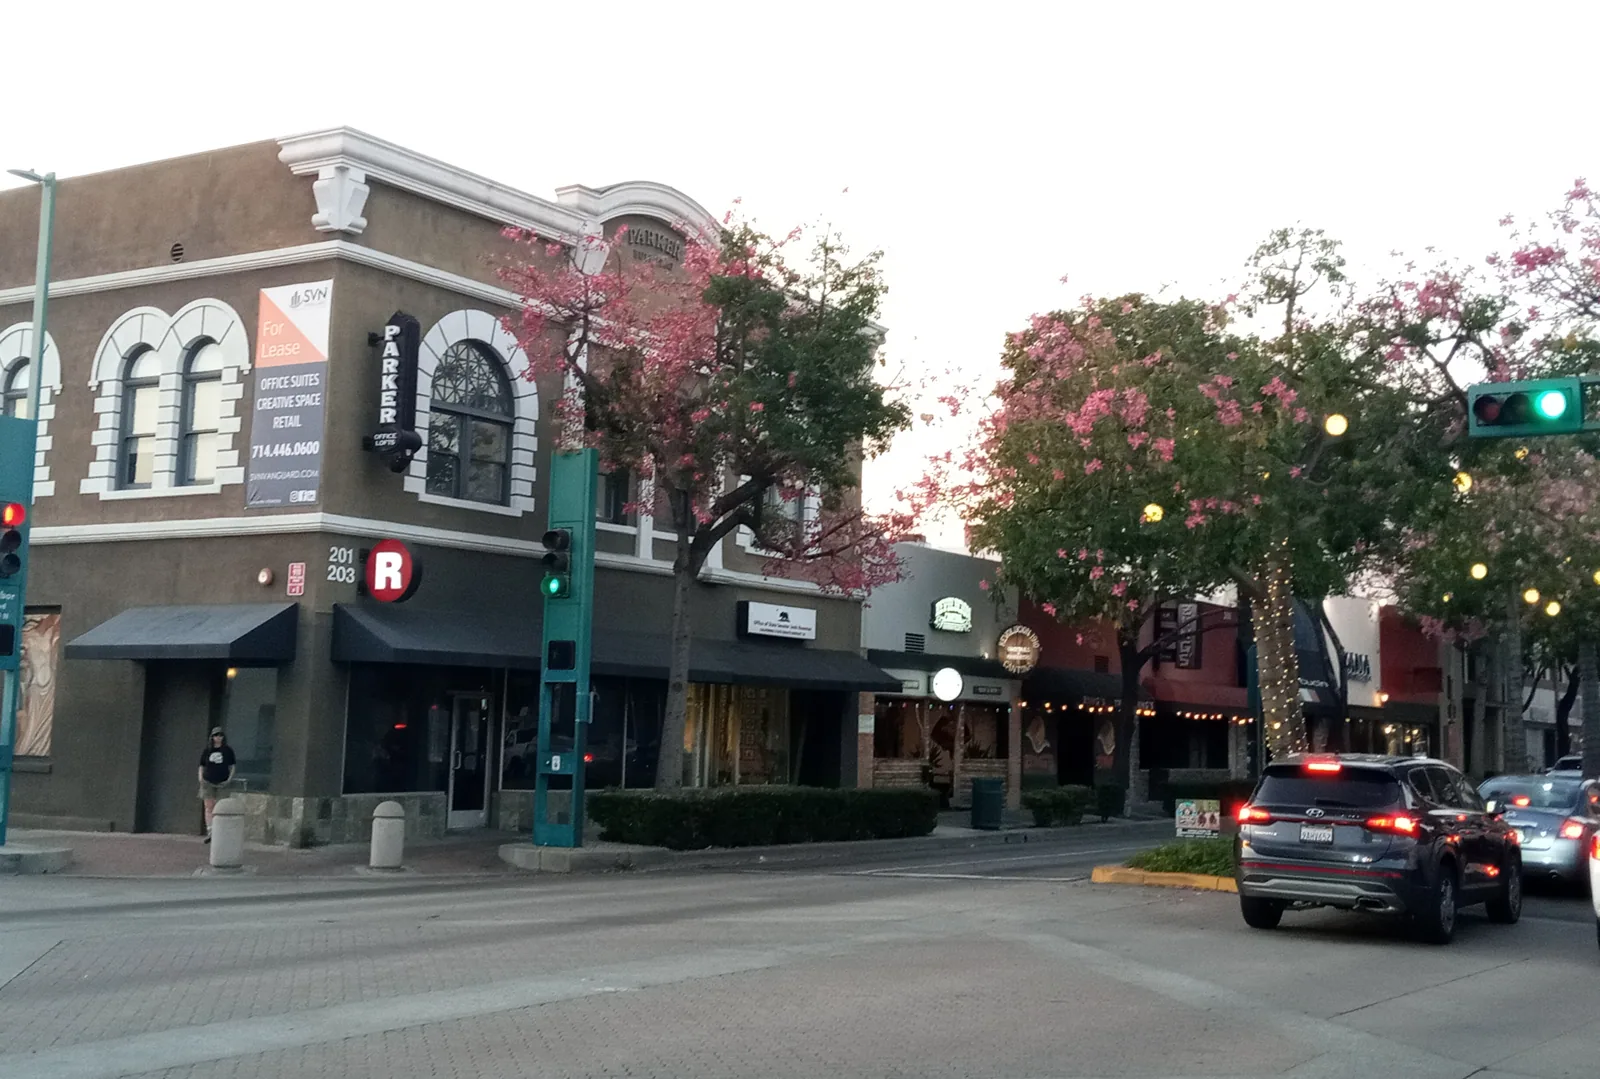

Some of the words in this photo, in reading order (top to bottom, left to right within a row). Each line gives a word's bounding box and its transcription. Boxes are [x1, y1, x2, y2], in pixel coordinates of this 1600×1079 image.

[628, 227, 681, 261] PARKER
[303, 287, 327, 302] SVN
[263, 320, 285, 337] For
[261, 342, 301, 359] Lease
[260, 375, 290, 391] OFFICE
[290, 372, 320, 389] SUITES
[380, 324, 401, 425] PARKER
[257, 396, 294, 412] CREATIVE
[295, 393, 321, 409] SPACE
[273, 415, 303, 430] RETAIL
[374, 432, 397, 440] OFFICE
[375, 438, 396, 446] LOFTS
[252, 440, 320, 459] 714.446.0600
[329, 547, 354, 565] 201
[326, 564, 356, 584] 203
[374, 551, 403, 591] R
